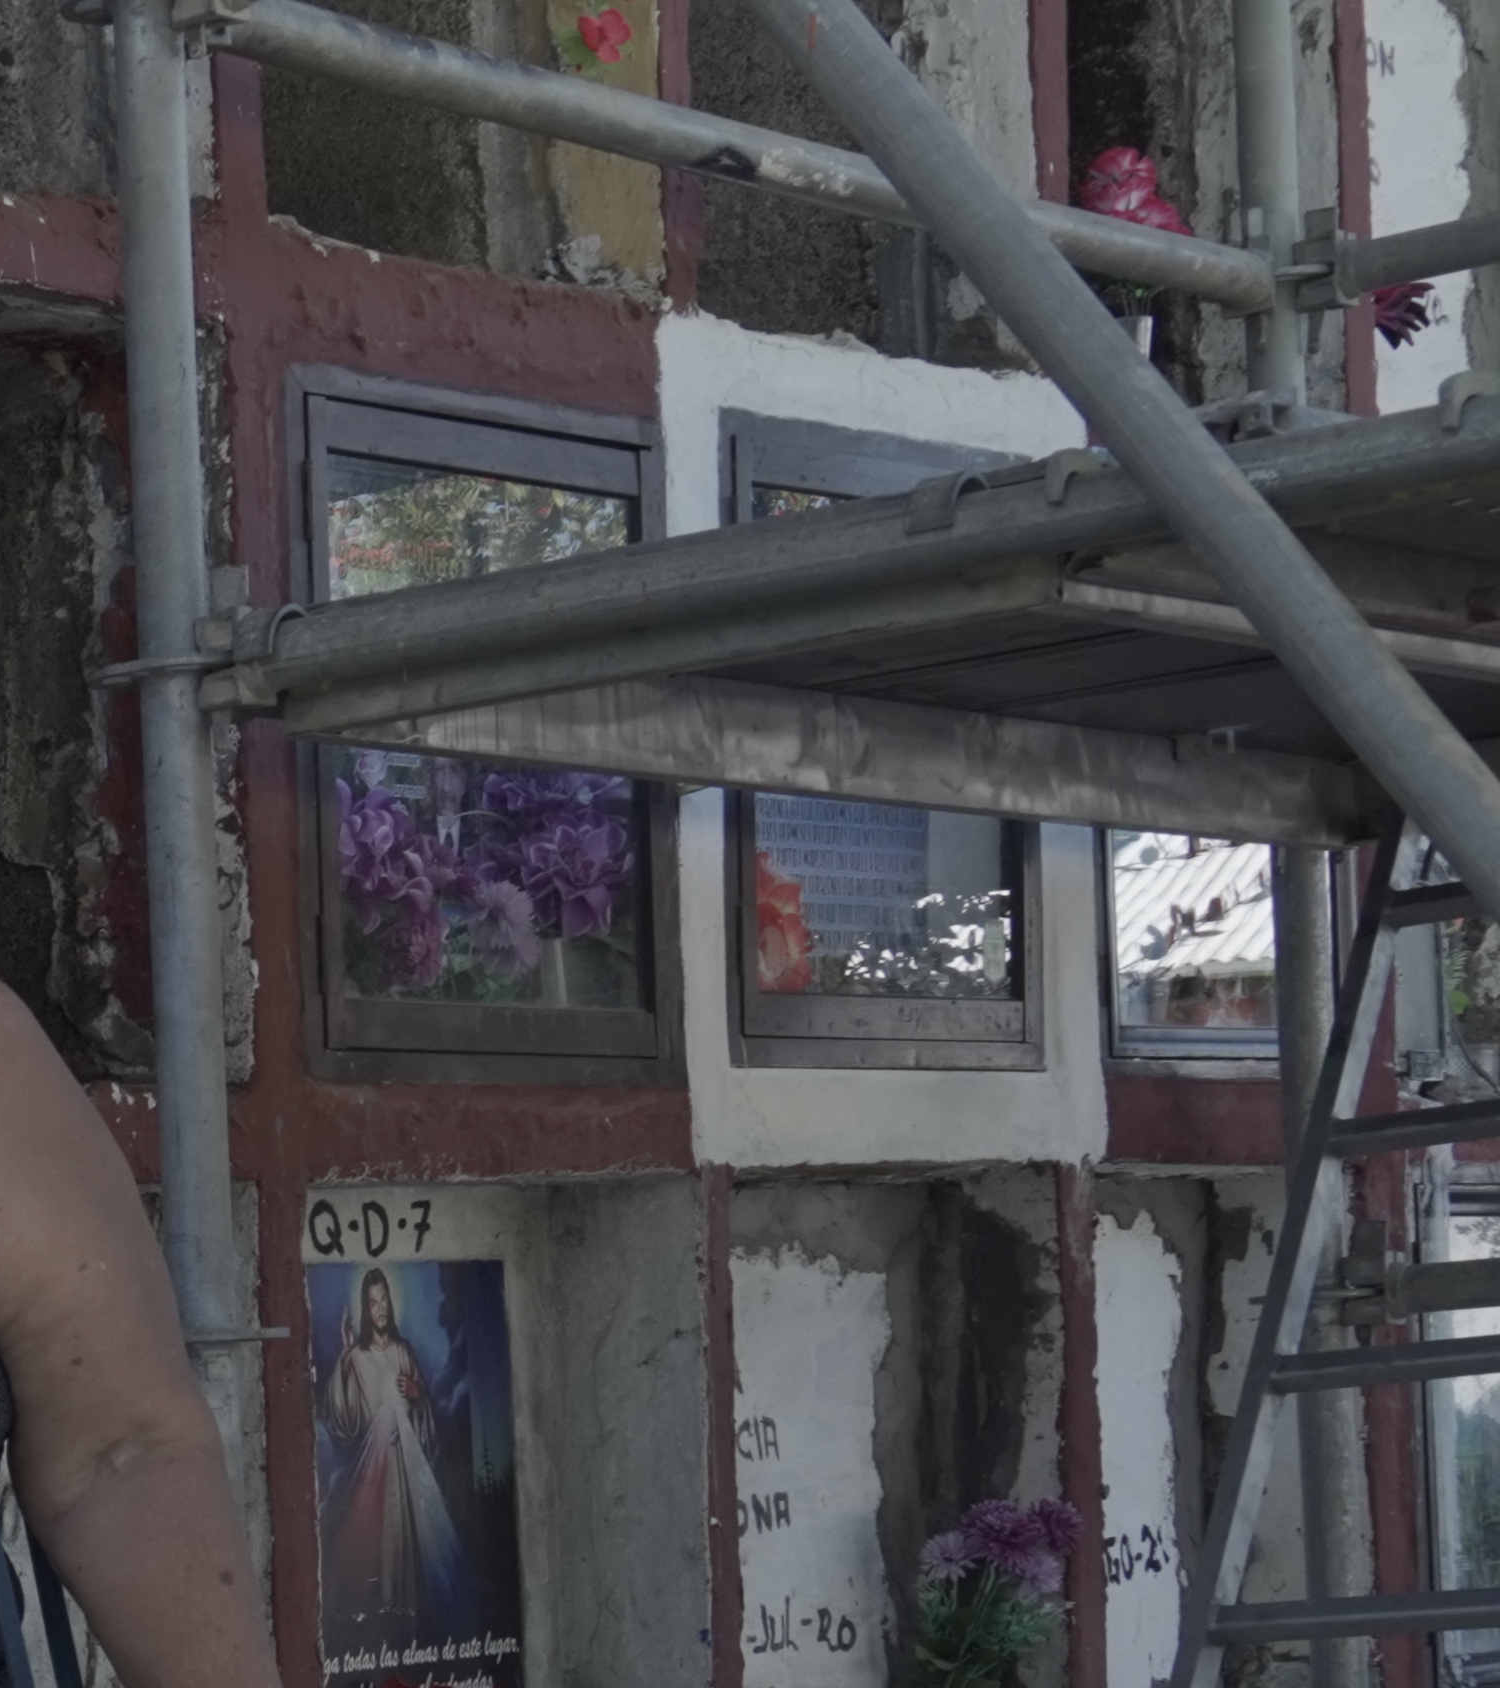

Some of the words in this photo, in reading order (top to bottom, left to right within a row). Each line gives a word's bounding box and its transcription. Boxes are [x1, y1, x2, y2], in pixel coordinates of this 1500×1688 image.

[343, 1646, 377, 1674] todas
[379, 1642, 400, 1669] las
[402, 1639, 440, 1665] almas
[441, 1636, 458, 1661] de
[458, 1637, 482, 1659] este
[484, 1630, 521, 1665] lugar.
